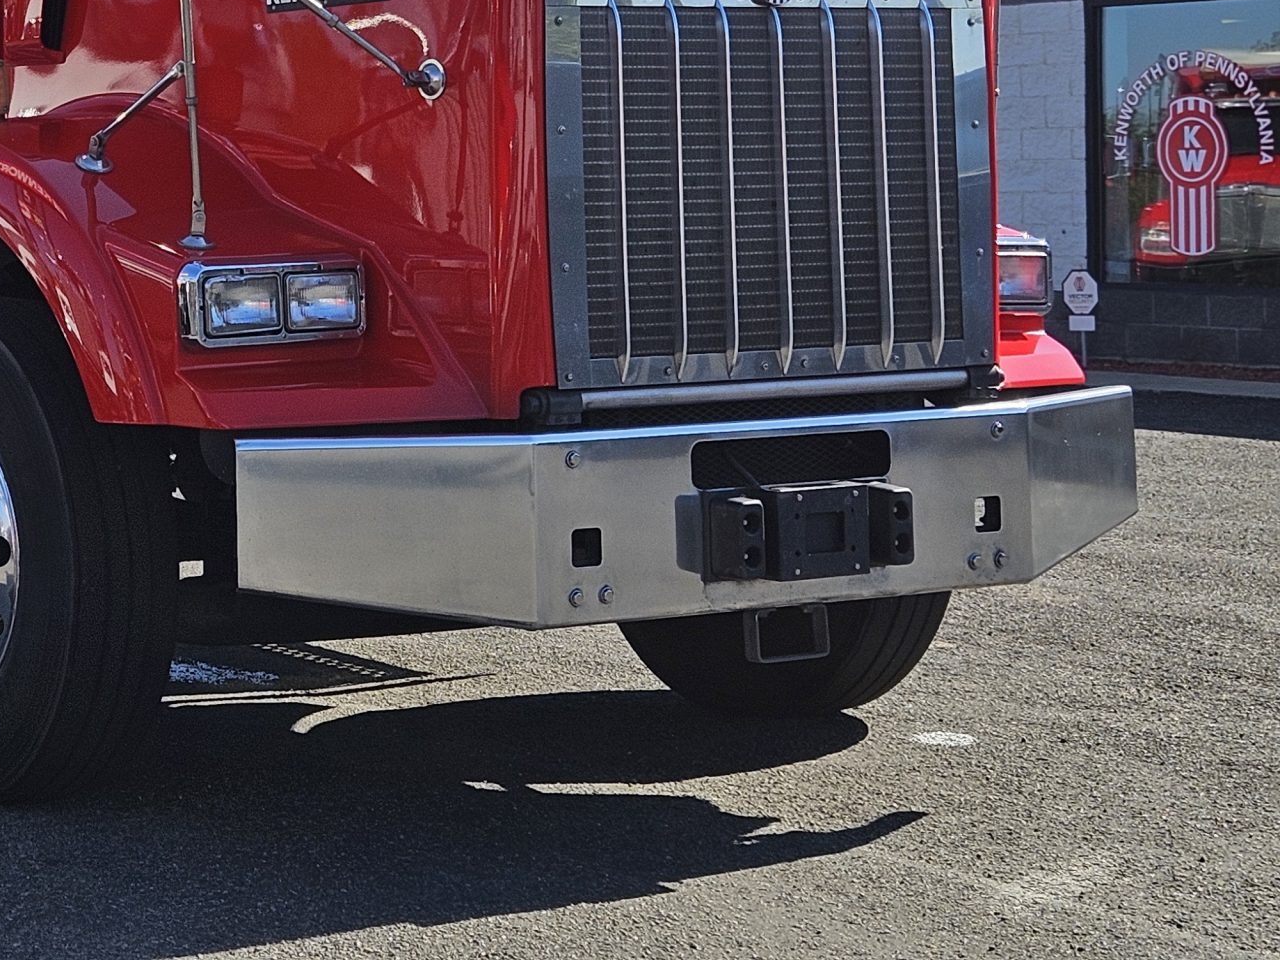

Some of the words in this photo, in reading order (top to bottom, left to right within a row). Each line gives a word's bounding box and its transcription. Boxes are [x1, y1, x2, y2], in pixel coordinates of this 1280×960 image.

[1114, 63, 1164, 162] KENWORTH
[1166, 51, 1190, 71] OF
[1194, 51, 1274, 166] PENNSYLVANIA
[1183, 125, 1202, 148] K
[1178, 149, 1206, 172] W
